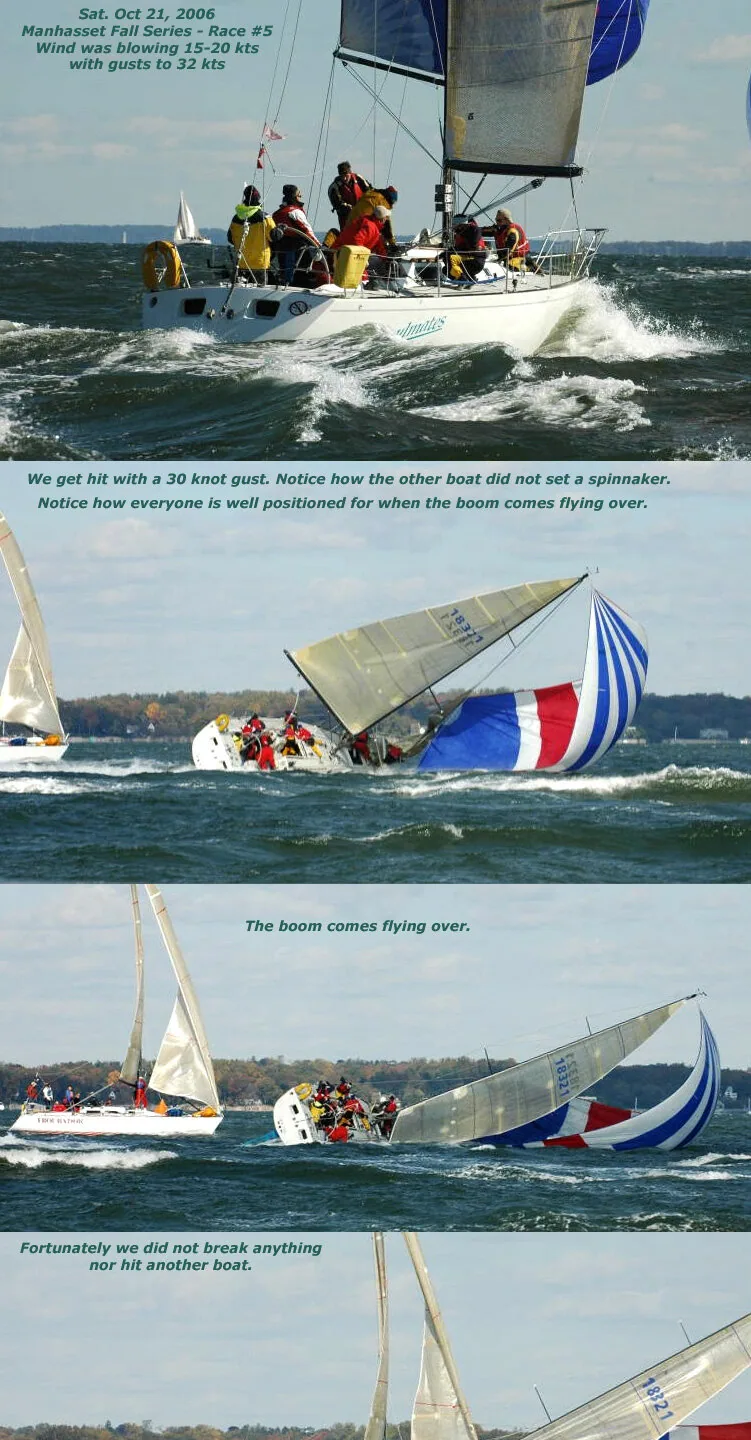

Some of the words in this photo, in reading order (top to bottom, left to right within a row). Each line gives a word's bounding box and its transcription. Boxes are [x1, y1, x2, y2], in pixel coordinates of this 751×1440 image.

[395, 315, 447, 340] ulmates
[555, 1057, 570, 1097] 18321
[642, 1377, 673, 1420] 18321
